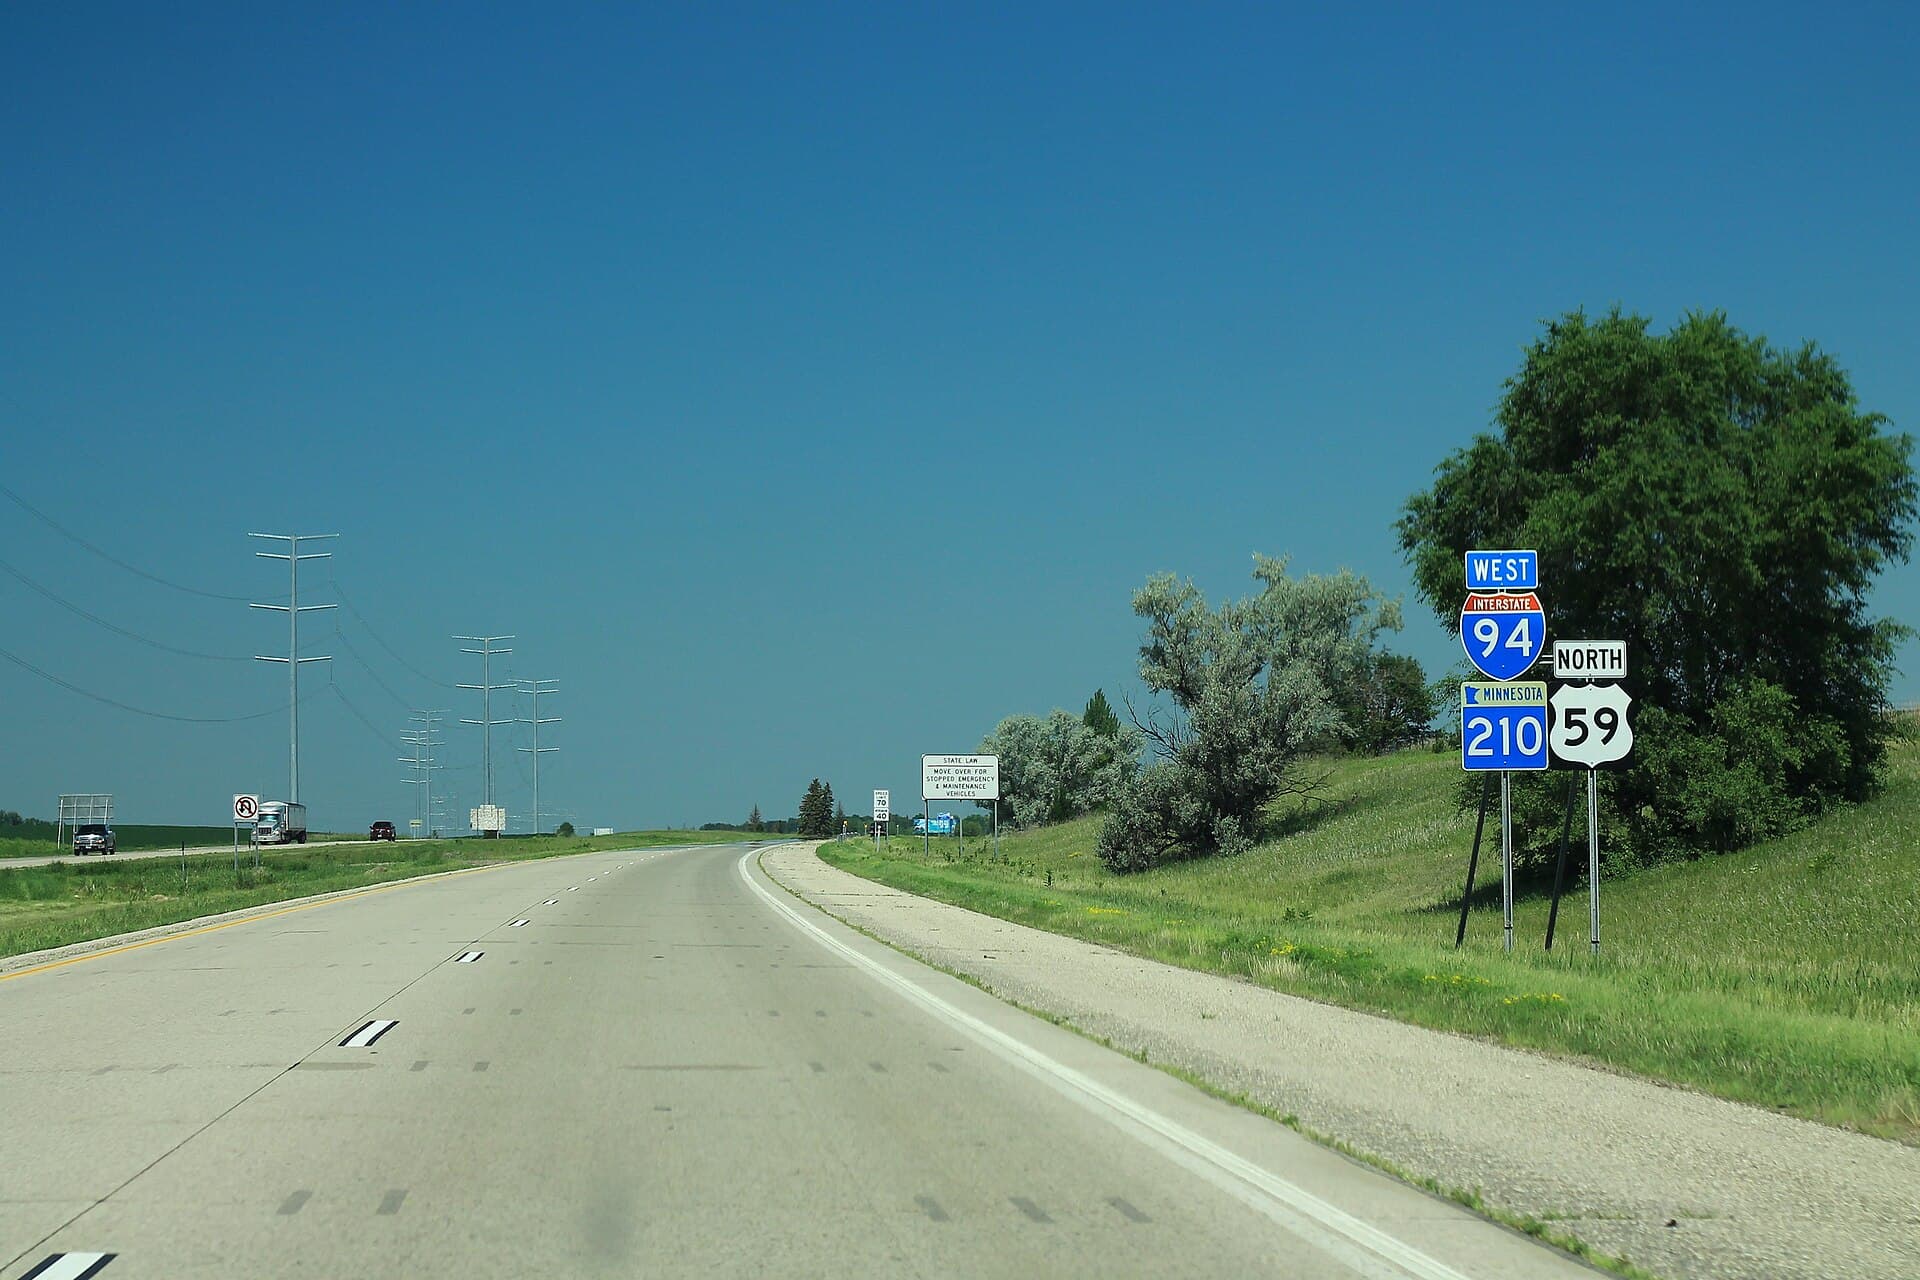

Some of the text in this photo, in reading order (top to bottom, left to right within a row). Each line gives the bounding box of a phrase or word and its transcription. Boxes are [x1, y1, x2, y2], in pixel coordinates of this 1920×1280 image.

[1474, 558, 1529, 581] WEST
[1473, 598, 1531, 610] INTERSTATE
[1473, 618, 1533, 658] 94
[1558, 648, 1622, 670] NORTH
[1483, 687, 1543, 701] MINNESOTA
[1467, 716, 1543, 756] 210
[1564, 707, 1619, 746] 59
[876, 812, 887, 820] 40
